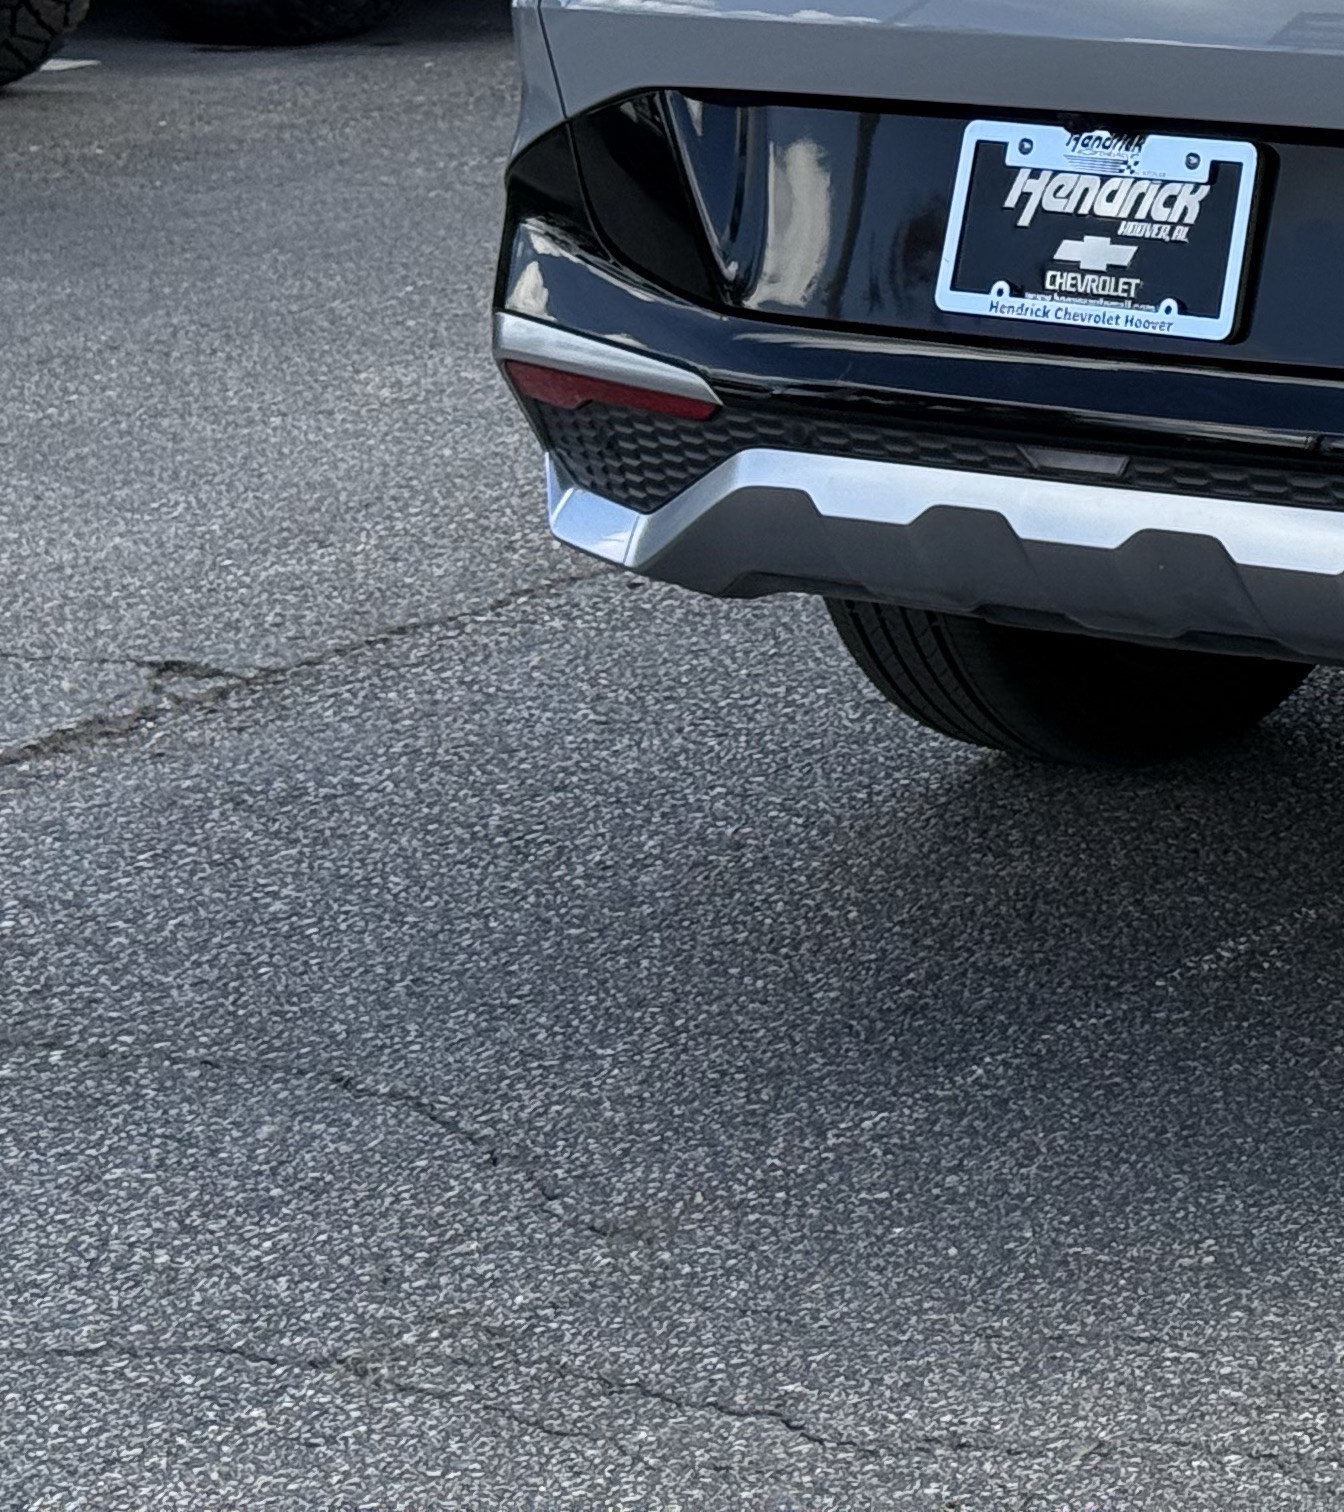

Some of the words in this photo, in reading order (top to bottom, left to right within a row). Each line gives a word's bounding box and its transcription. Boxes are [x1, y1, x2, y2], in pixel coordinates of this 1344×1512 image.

[1003, 168, 1210, 227] Hendrick
[1045, 269, 1141, 298] CHEVROLET
[989, 300, 1051, 321] Hendrick
[1054, 308, 1121, 327] Chevrolet
[1124, 314, 1174, 333] Hoover
